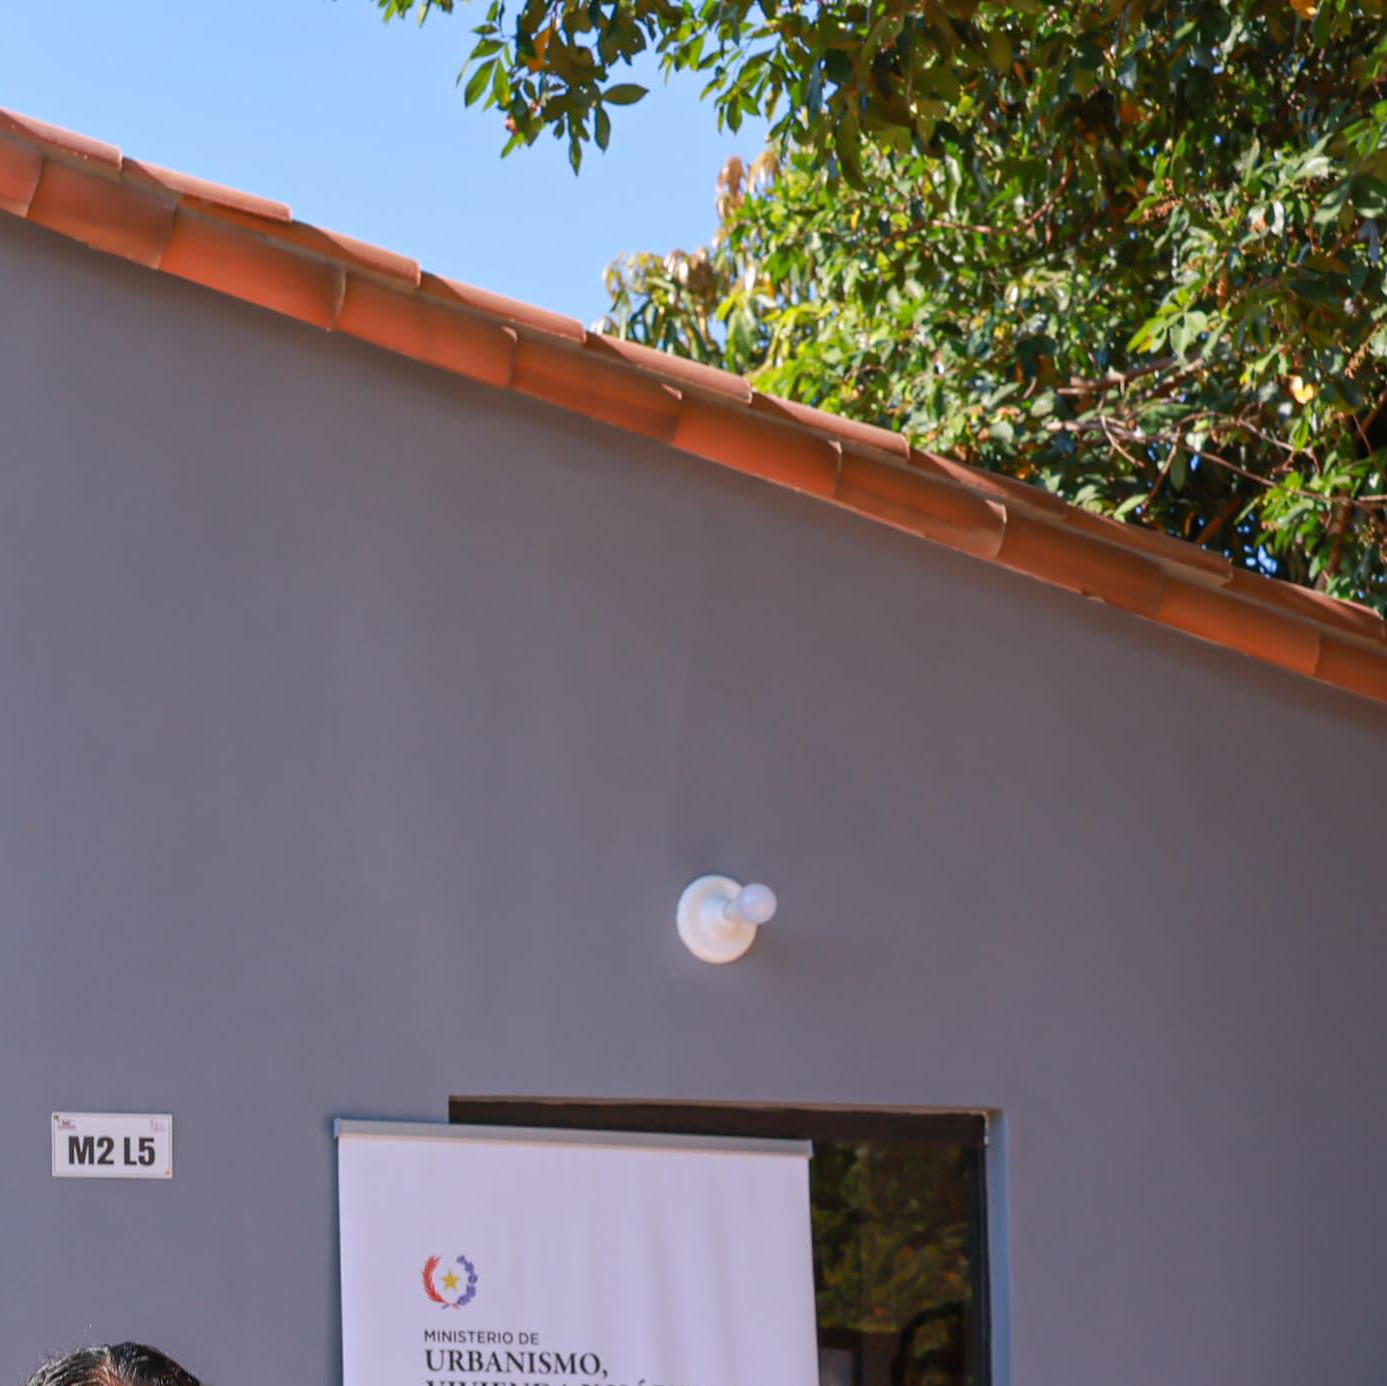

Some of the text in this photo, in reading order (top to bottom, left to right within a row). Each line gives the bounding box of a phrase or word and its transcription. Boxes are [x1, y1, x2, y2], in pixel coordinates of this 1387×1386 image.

[68, 1135, 156, 1166] M2 L5
[424, 1329, 540, 1345] MINISTERIO DE
[426, 1349, 608, 1379] URBANISMO,
